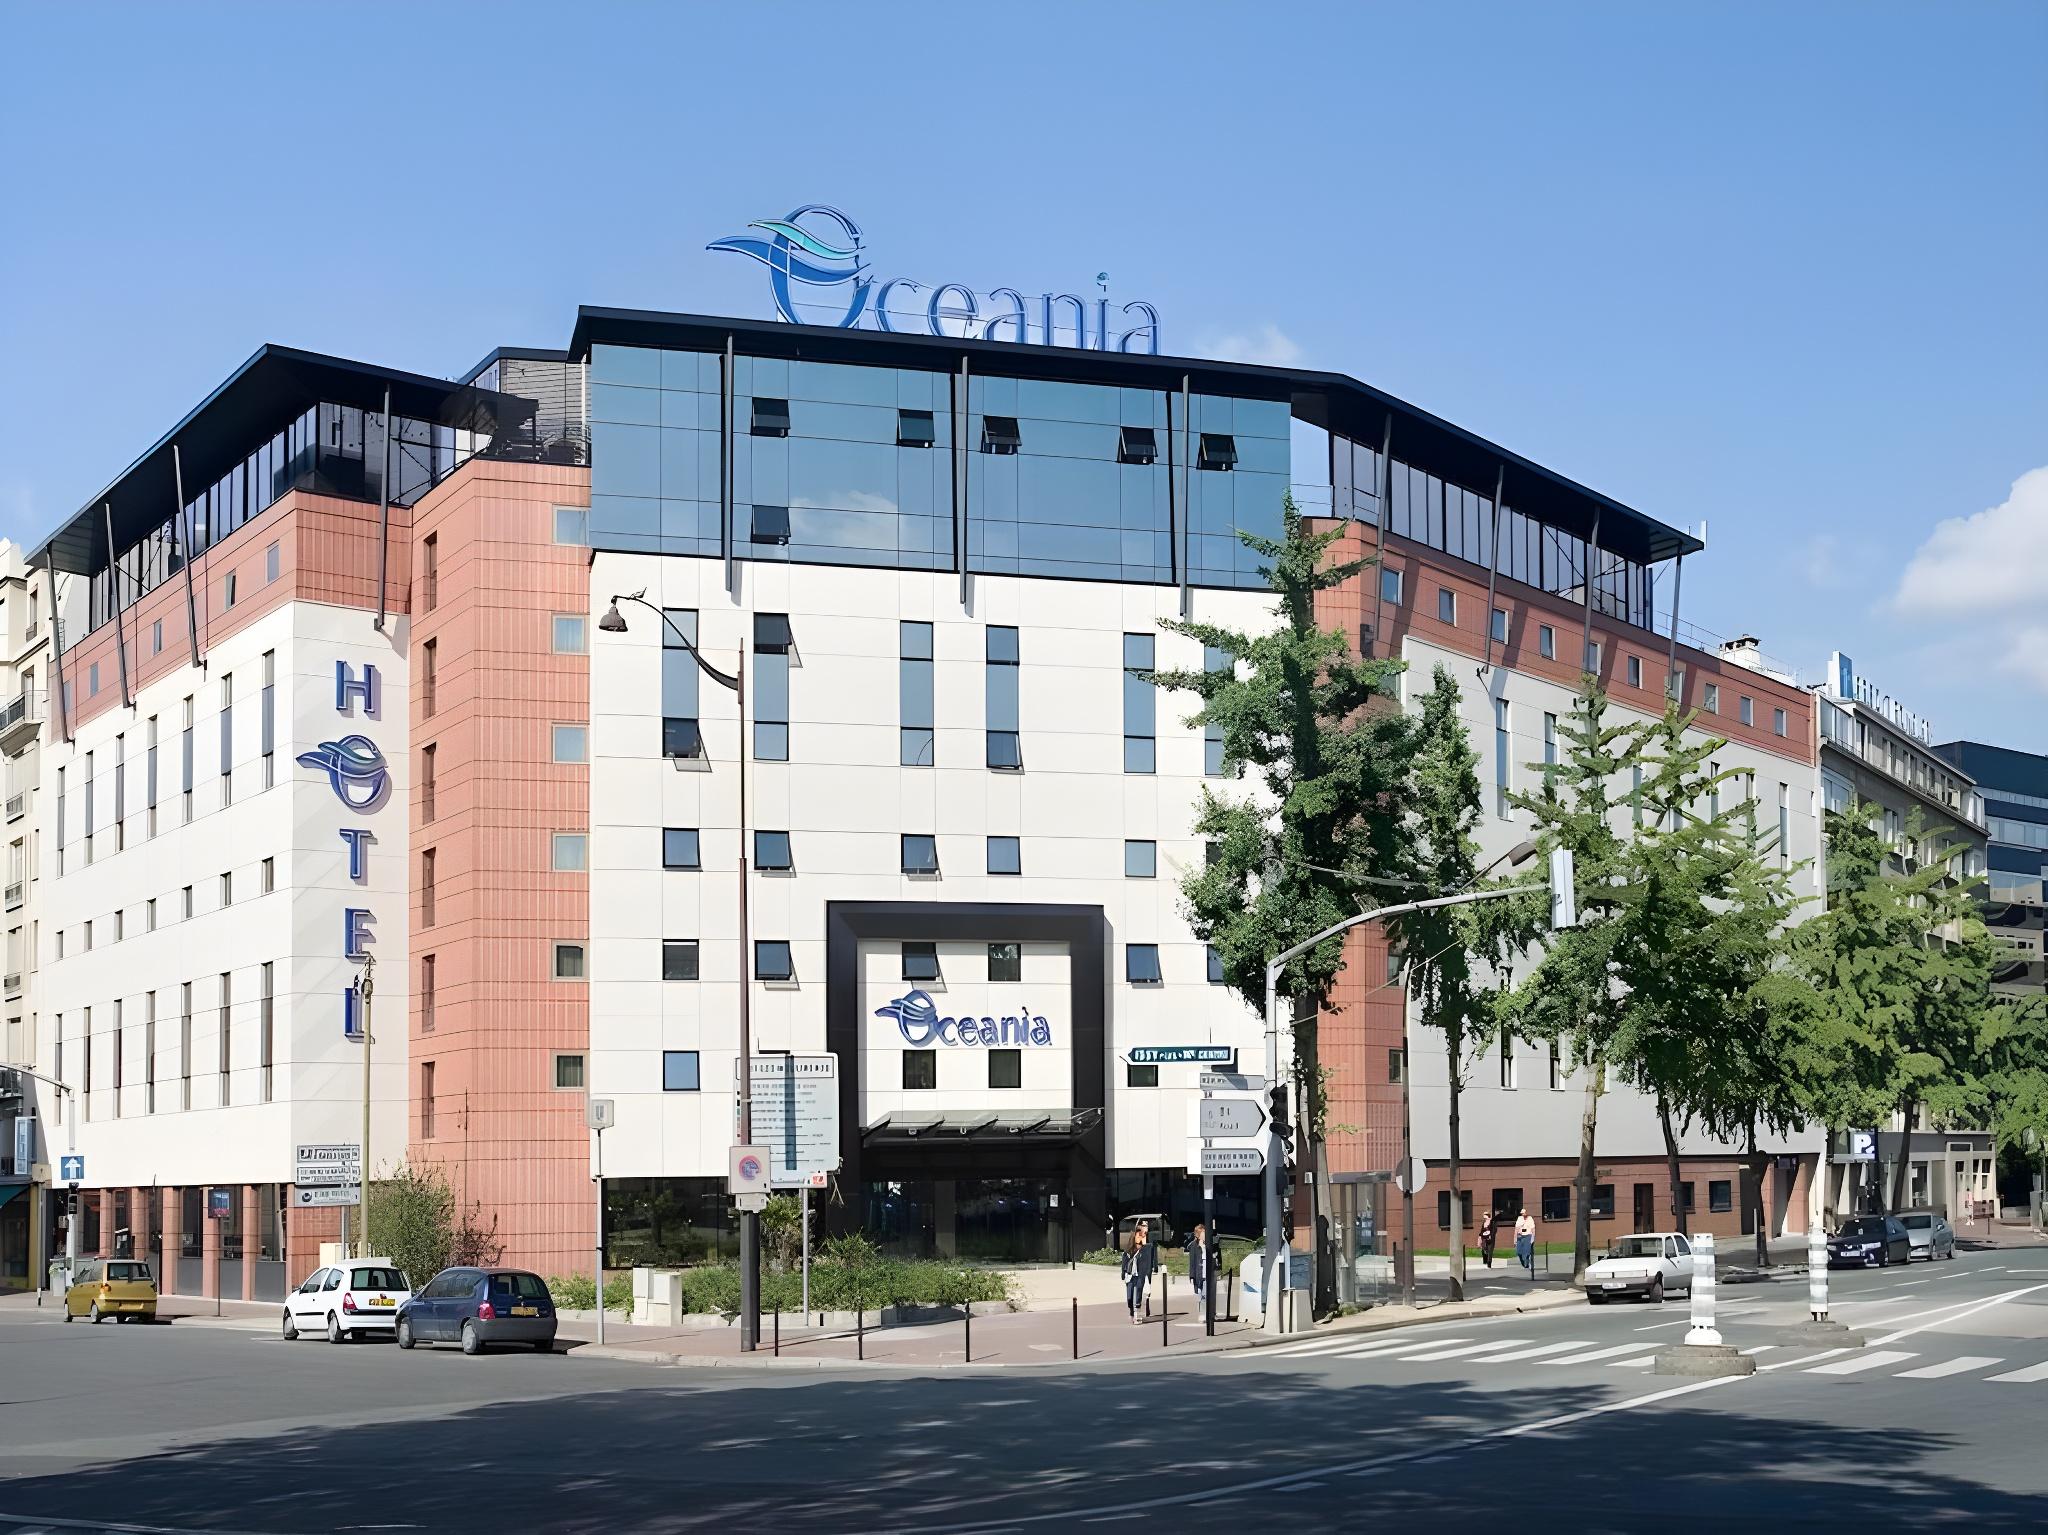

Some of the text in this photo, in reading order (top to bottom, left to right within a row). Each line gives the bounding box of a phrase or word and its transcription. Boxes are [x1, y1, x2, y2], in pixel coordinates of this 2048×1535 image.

[706, 204, 1161, 355] Oceania
[296, 660, 390, 1043] HOTEL
[875, 989, 1053, 1048] Oceania
